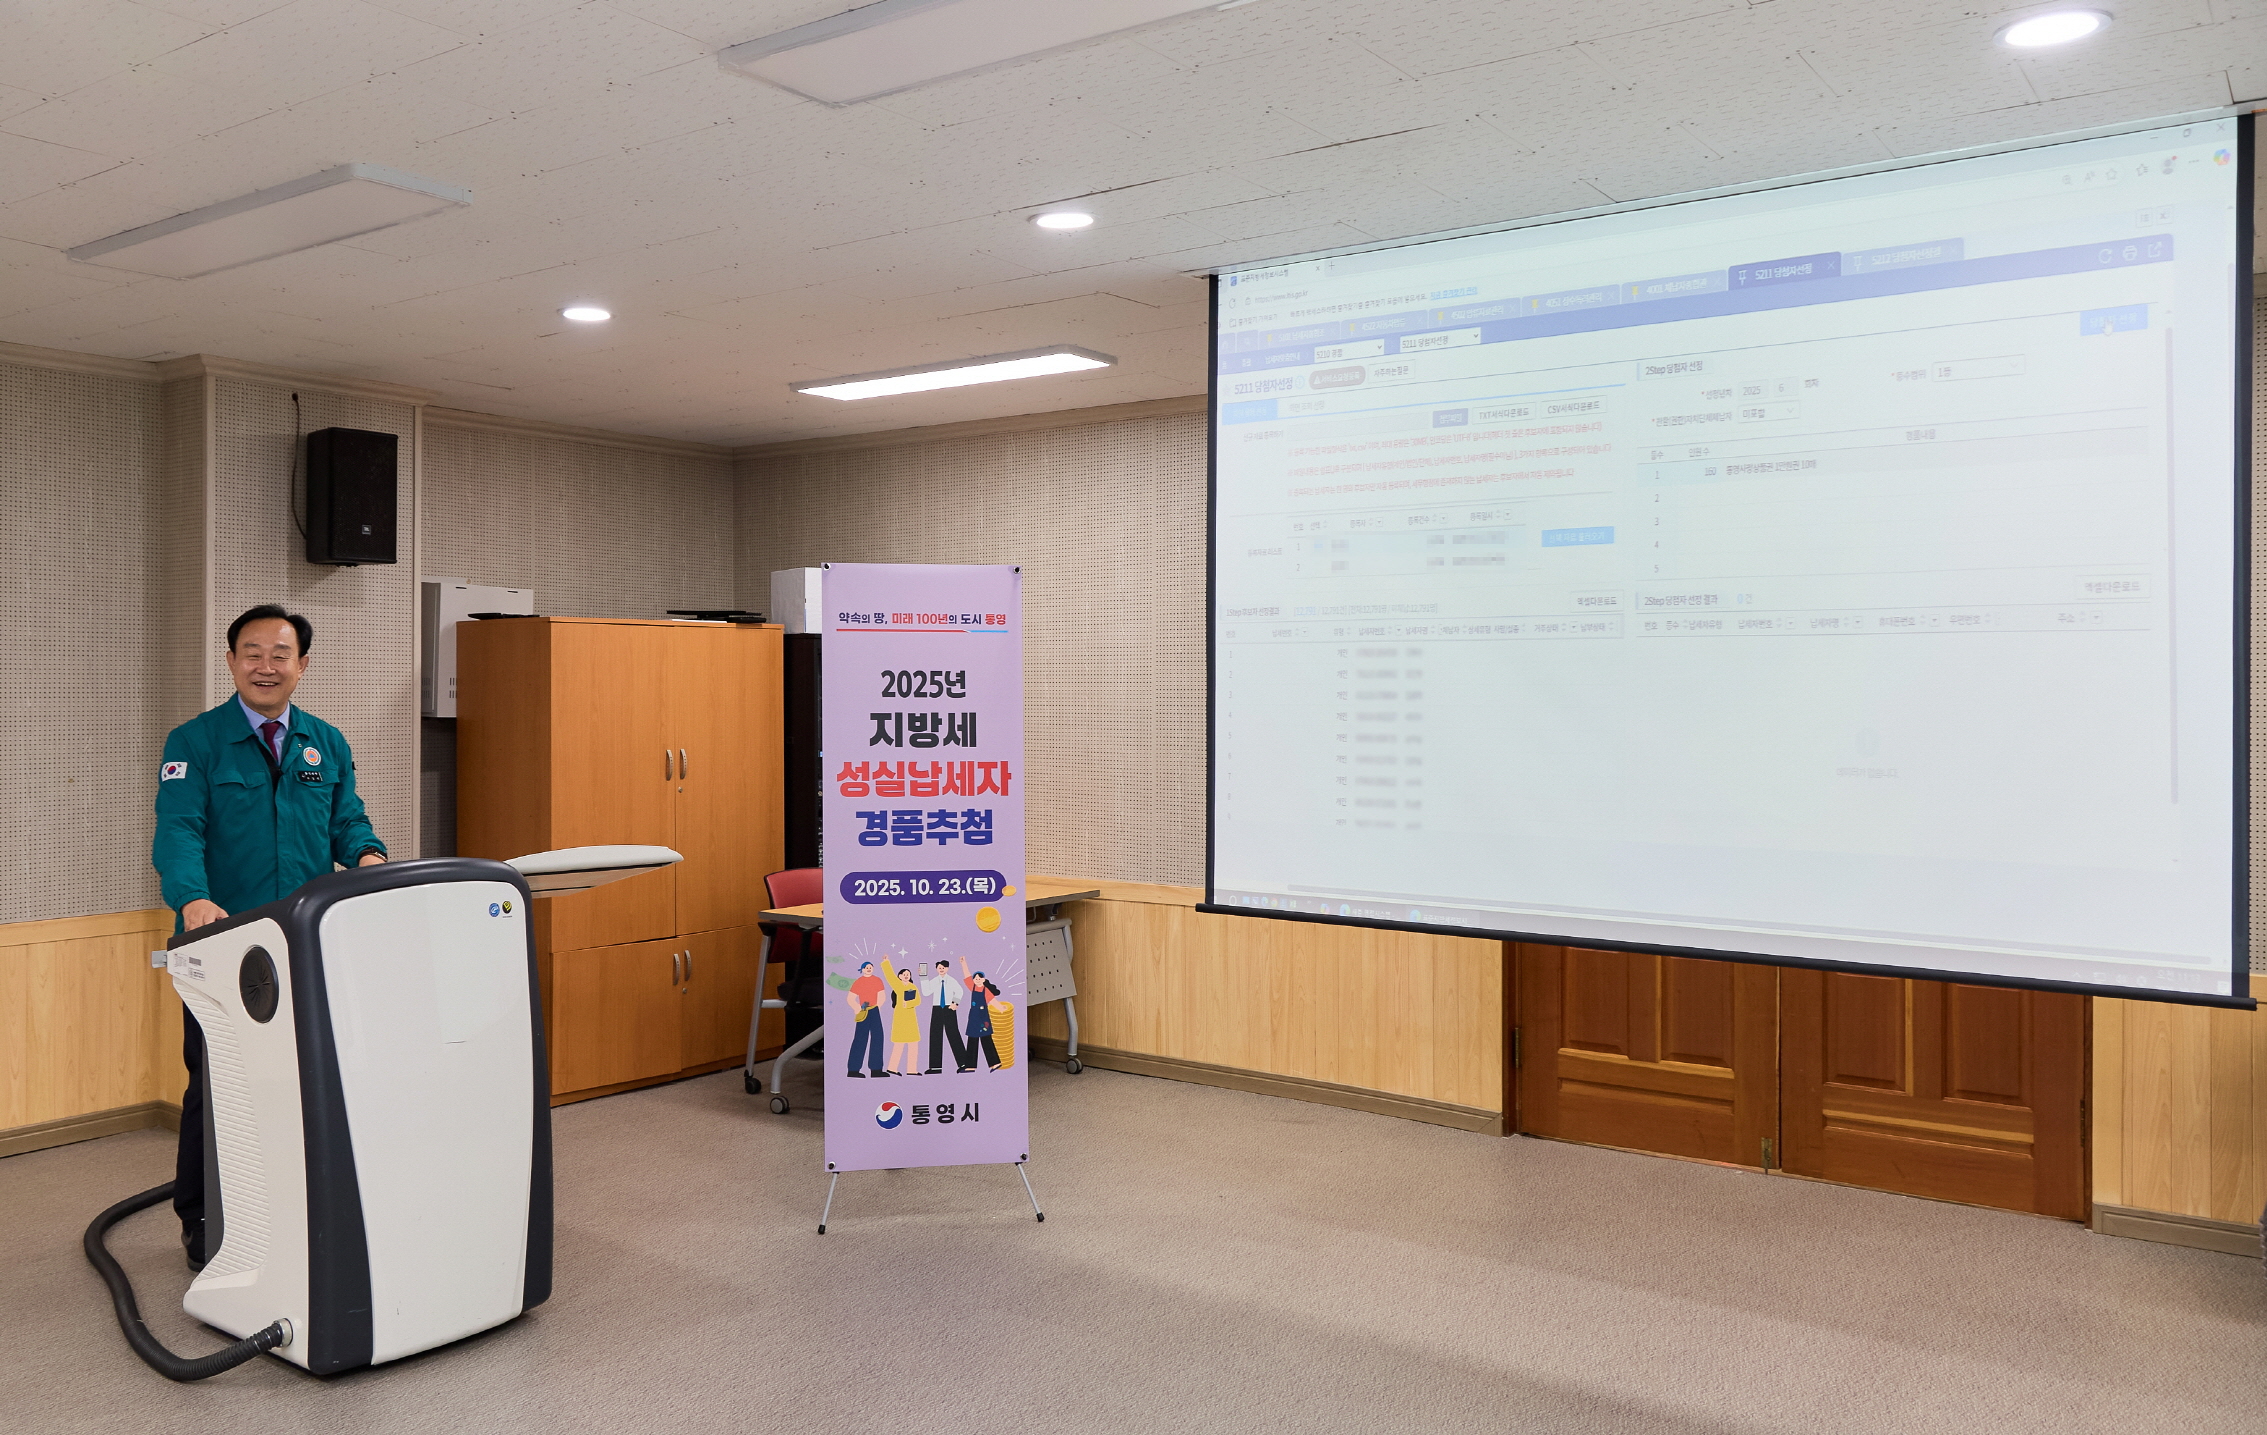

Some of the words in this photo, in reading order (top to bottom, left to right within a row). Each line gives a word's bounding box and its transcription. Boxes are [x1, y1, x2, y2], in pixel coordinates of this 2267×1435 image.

[1755, 268, 1772, 281] 5211
[1774, 262, 1812, 278] 당첨자선정
[1337, 301, 1363, 313] 즐겨찾기를
[1364, 298, 1385, 309] 즐겨찾기
[1401, 339, 1416, 349] 5211
[1418, 335, 1448, 347] 당첨자선정
[1316, 349, 1330, 359] 5210
[1374, 365, 1408, 378] 자주하는질문
[1645, 364, 1665, 378] 2Step
[1666, 362, 1687, 375] 당첨자
[1689, 360, 1702, 373] 선정
[1234, 381, 1253, 395] 5211
[1254, 376, 1292, 393] 당첨자선정
[1742, 385, 1760, 396] 2025
[1778, 383, 1783, 392] 6
[1547, 400, 1600, 414] CSV서식다운로드
[1479, 406, 1529, 420] TXT서식다운로드
[1742, 408, 1764, 419] 미포함
[1704, 466, 1716, 476] 160
[1654, 493, 1659, 503] 2
[1407, 514, 1430, 525] 등록건수
[1470, 510, 1493, 521] 등록일시
[1654, 517, 1659, 525] 3
[1654, 540, 1659, 548] 4
[1296, 563, 1300, 571] 2
[1654, 564, 1659, 573] 5
[1577, 596, 1616, 606] 엑셀다운로드
[1644, 596, 1664, 606] 2Step
[1665, 595, 1686, 606] 당첨자
[1687, 595, 1701, 605] 선정
[1703, 594, 1717, 605] 결과
[838, 612, 871, 624] 약속의
[873, 612, 888, 625] 땅,
[891, 613, 913, 624] 미래
[916, 613, 957, 625] 100년의
[960, 613, 982, 625] 도시
[984, 614, 1007, 625] 통영
[1810, 617, 1839, 628] 납세자명
[2057, 612, 2074, 623] 주소
[1644, 620, 1658, 631] 번호
[1688, 619, 1722, 630] 납세자유형
[1737, 618, 1772, 629] 납세자번호
[880, 669, 966, 698] 2025년
[869, 711, 977, 748] 지방세
[836, 760, 1012, 798] 성실납세자
[855, 808, 993, 846] 경품추첨
[854, 879, 905, 896] 2025.
[909, 879, 934, 895] 10.
[938, 877, 996, 895] 23.(목)
[911, 1102, 979, 1124] 통영시
